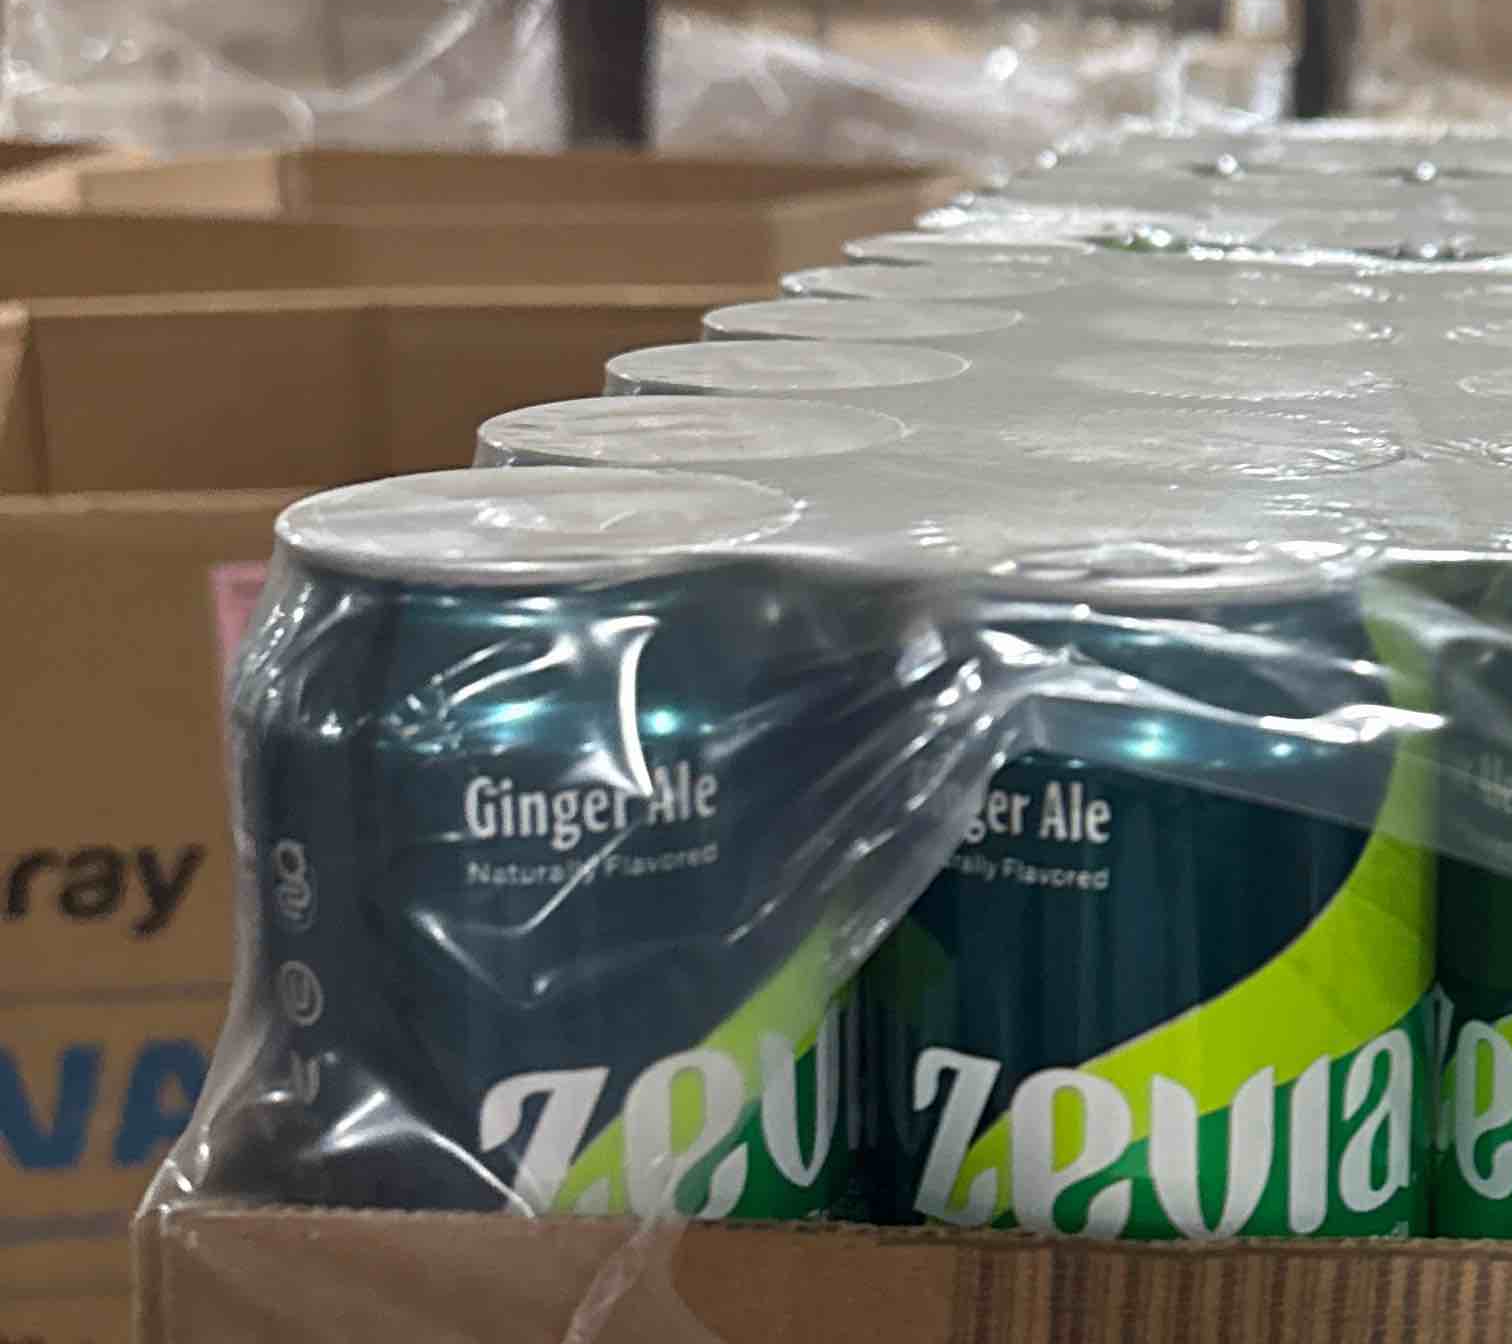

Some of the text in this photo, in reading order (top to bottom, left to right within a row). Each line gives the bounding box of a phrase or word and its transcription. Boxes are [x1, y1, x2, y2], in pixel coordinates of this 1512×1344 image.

[464, 760, 719, 851] Ginger Ale
[1038, 780, 1112, 844] Ale
